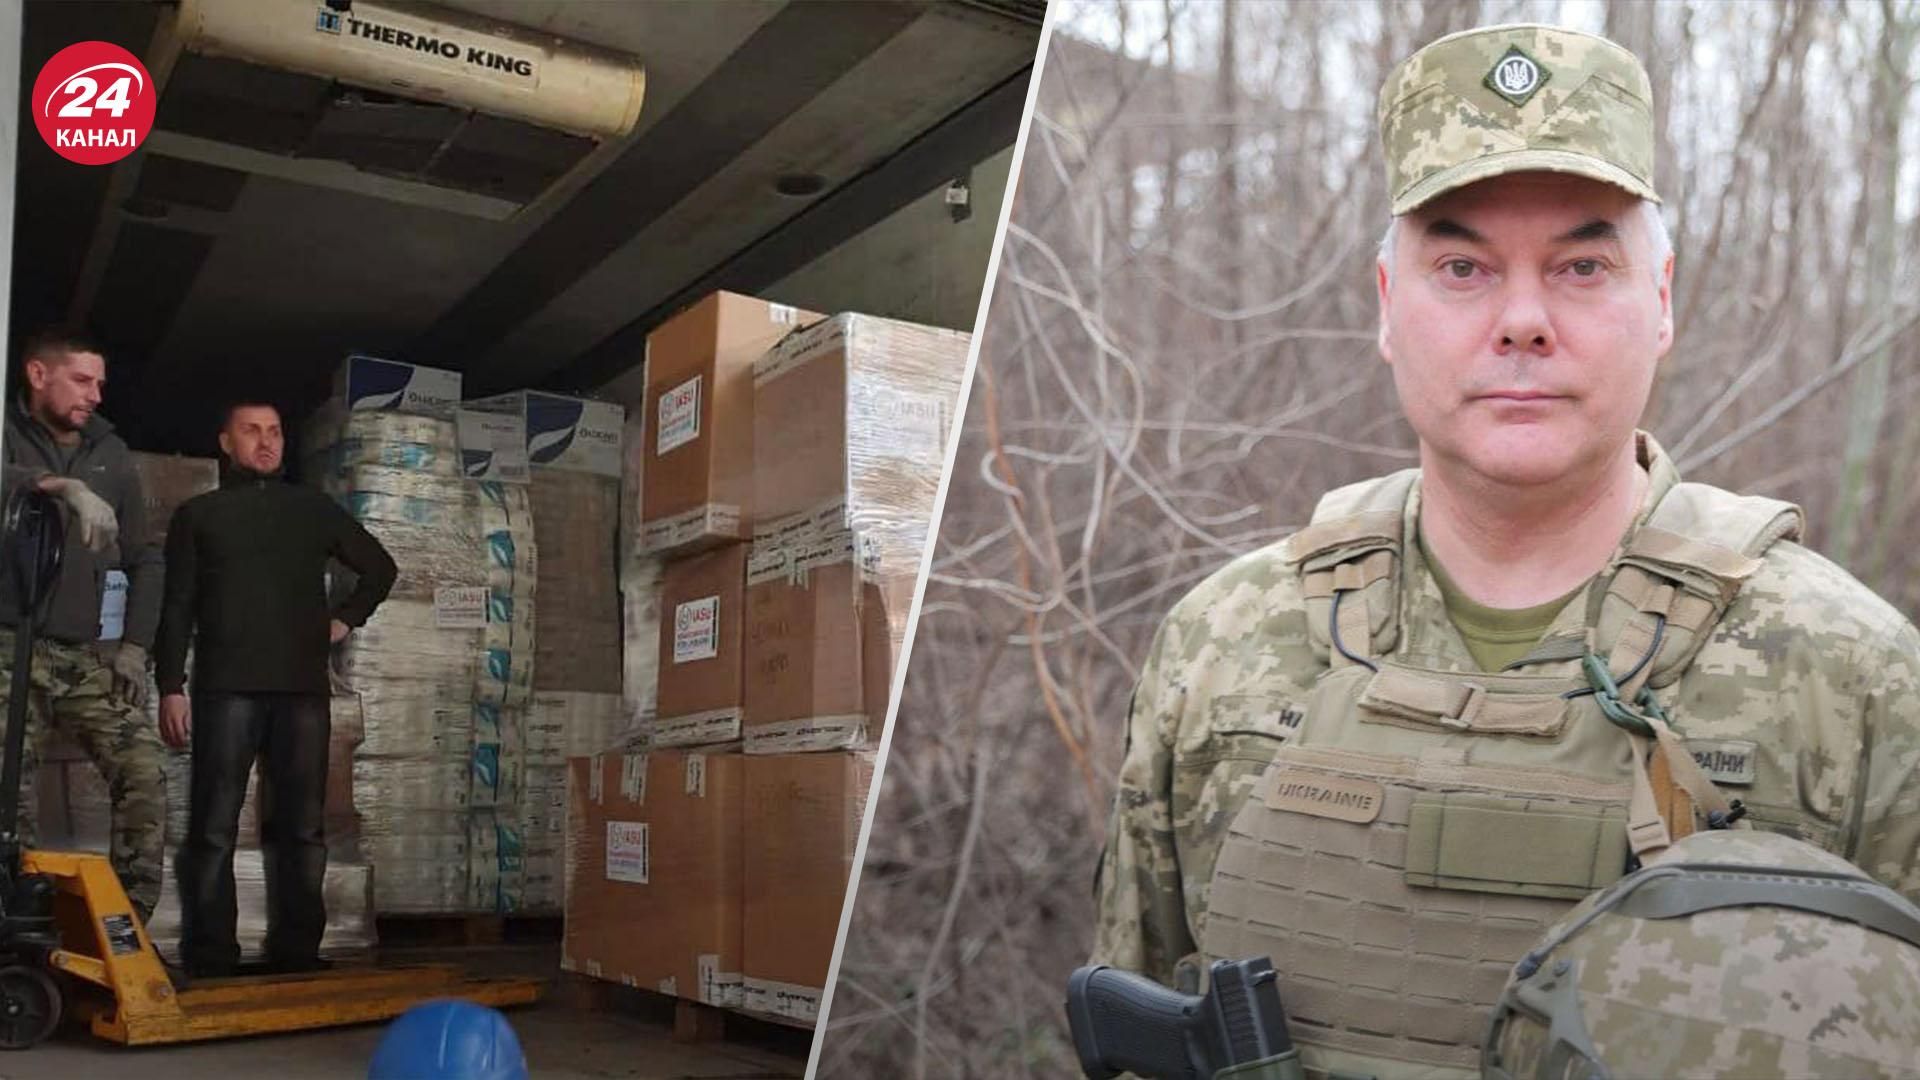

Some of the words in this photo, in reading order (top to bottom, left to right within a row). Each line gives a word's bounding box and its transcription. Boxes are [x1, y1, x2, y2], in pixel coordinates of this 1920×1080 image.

[347, 17, 460, 59] THERMO
[466, 47, 533, 77] KING
[1691, 750, 1745, 774] РАЇНИ
[1277, 782, 1374, 811] UKRAINE
